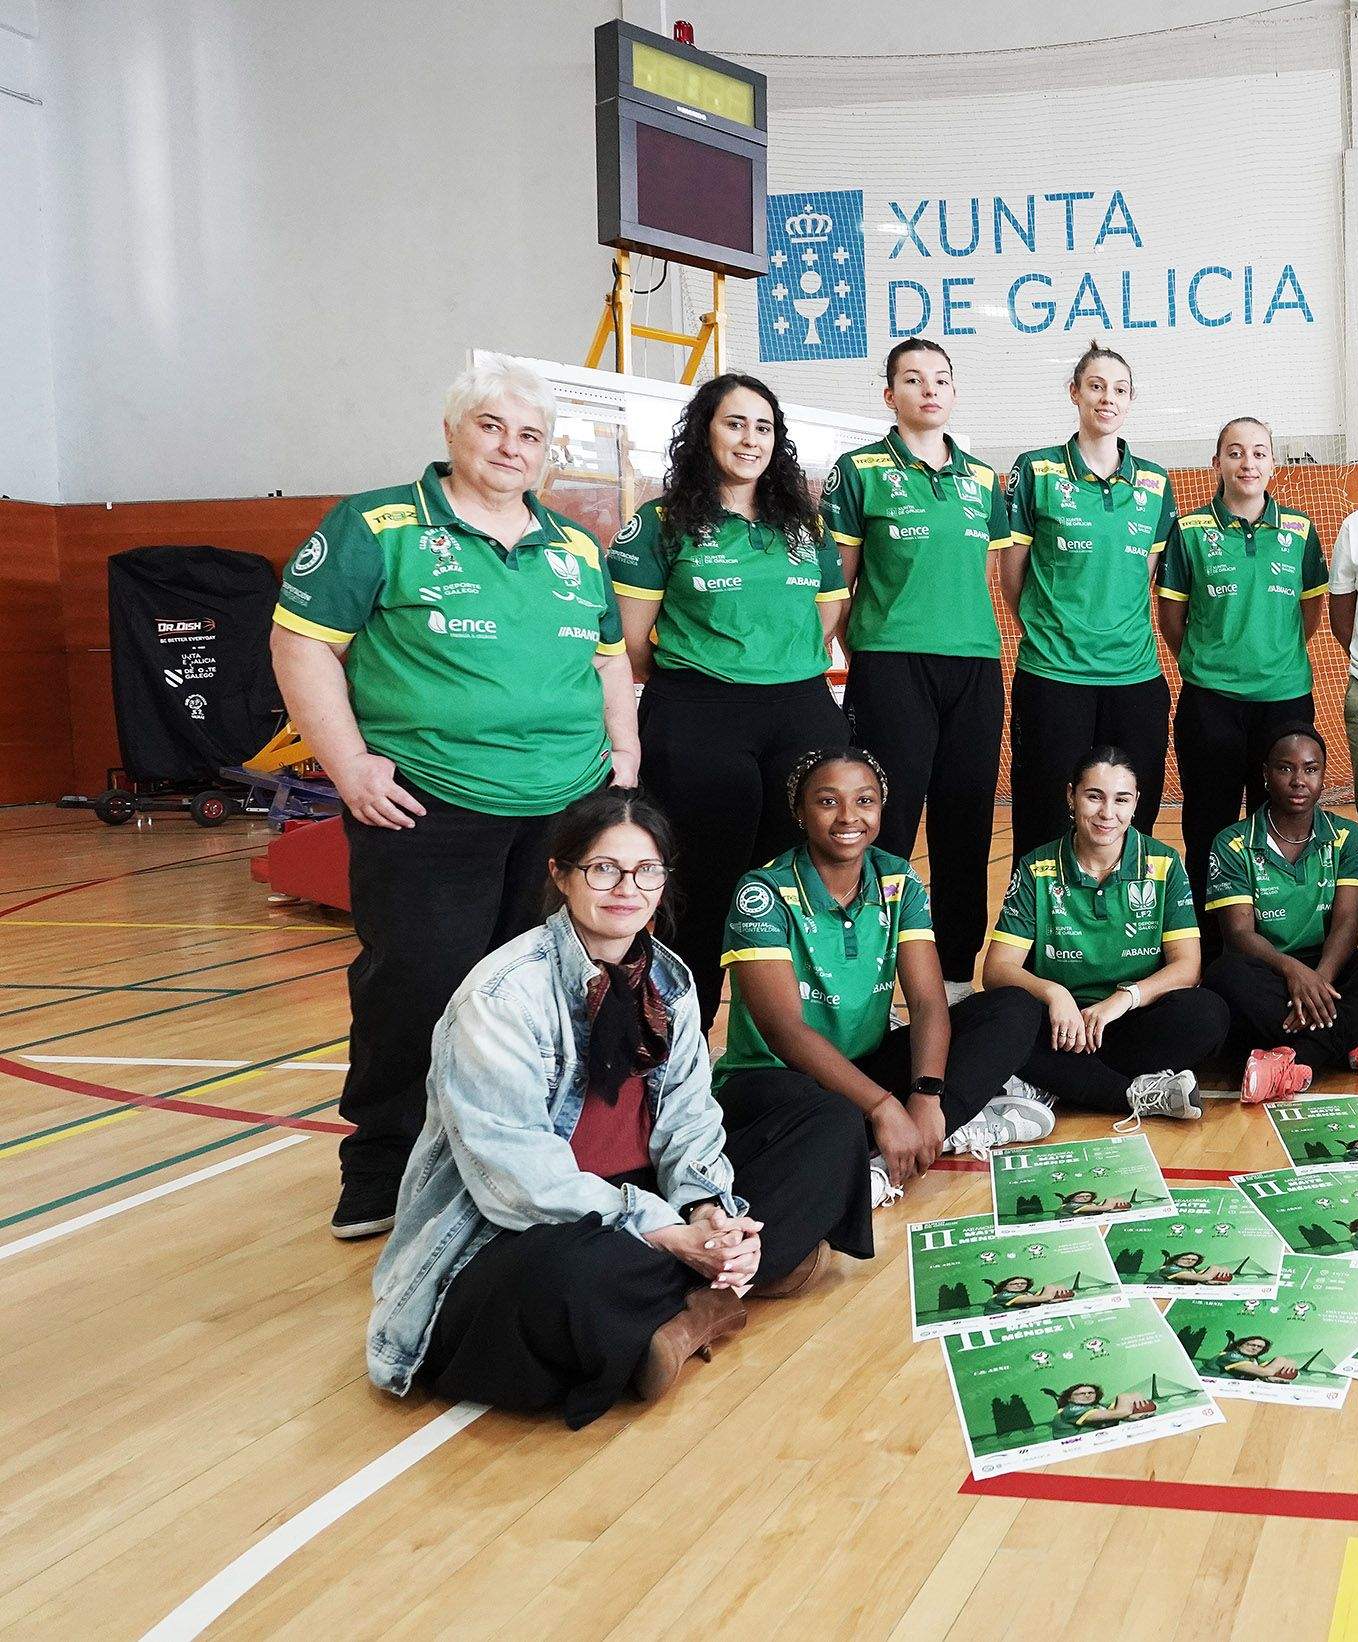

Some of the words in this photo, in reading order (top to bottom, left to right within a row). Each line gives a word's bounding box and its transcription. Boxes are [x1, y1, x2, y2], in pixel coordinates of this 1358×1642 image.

[888, 189, 1143, 259] XUNTA
[888, 277, 977, 338] DE
[1008, 264, 1316, 334] GALICIA
[901, 525, 929, 538] ence
[1068, 539, 1093, 550] ence
[707, 577, 742, 589] ence
[1217, 584, 1237, 595] ence
[448, 618, 497, 633] ence
[1262, 908, 1286, 919] ence
[1056, 949, 1083, 959] ence
[811, 989, 840, 1005] ence
[964, 1229, 996, 1237] MAIT
[920, 1229, 957, 1251] II
